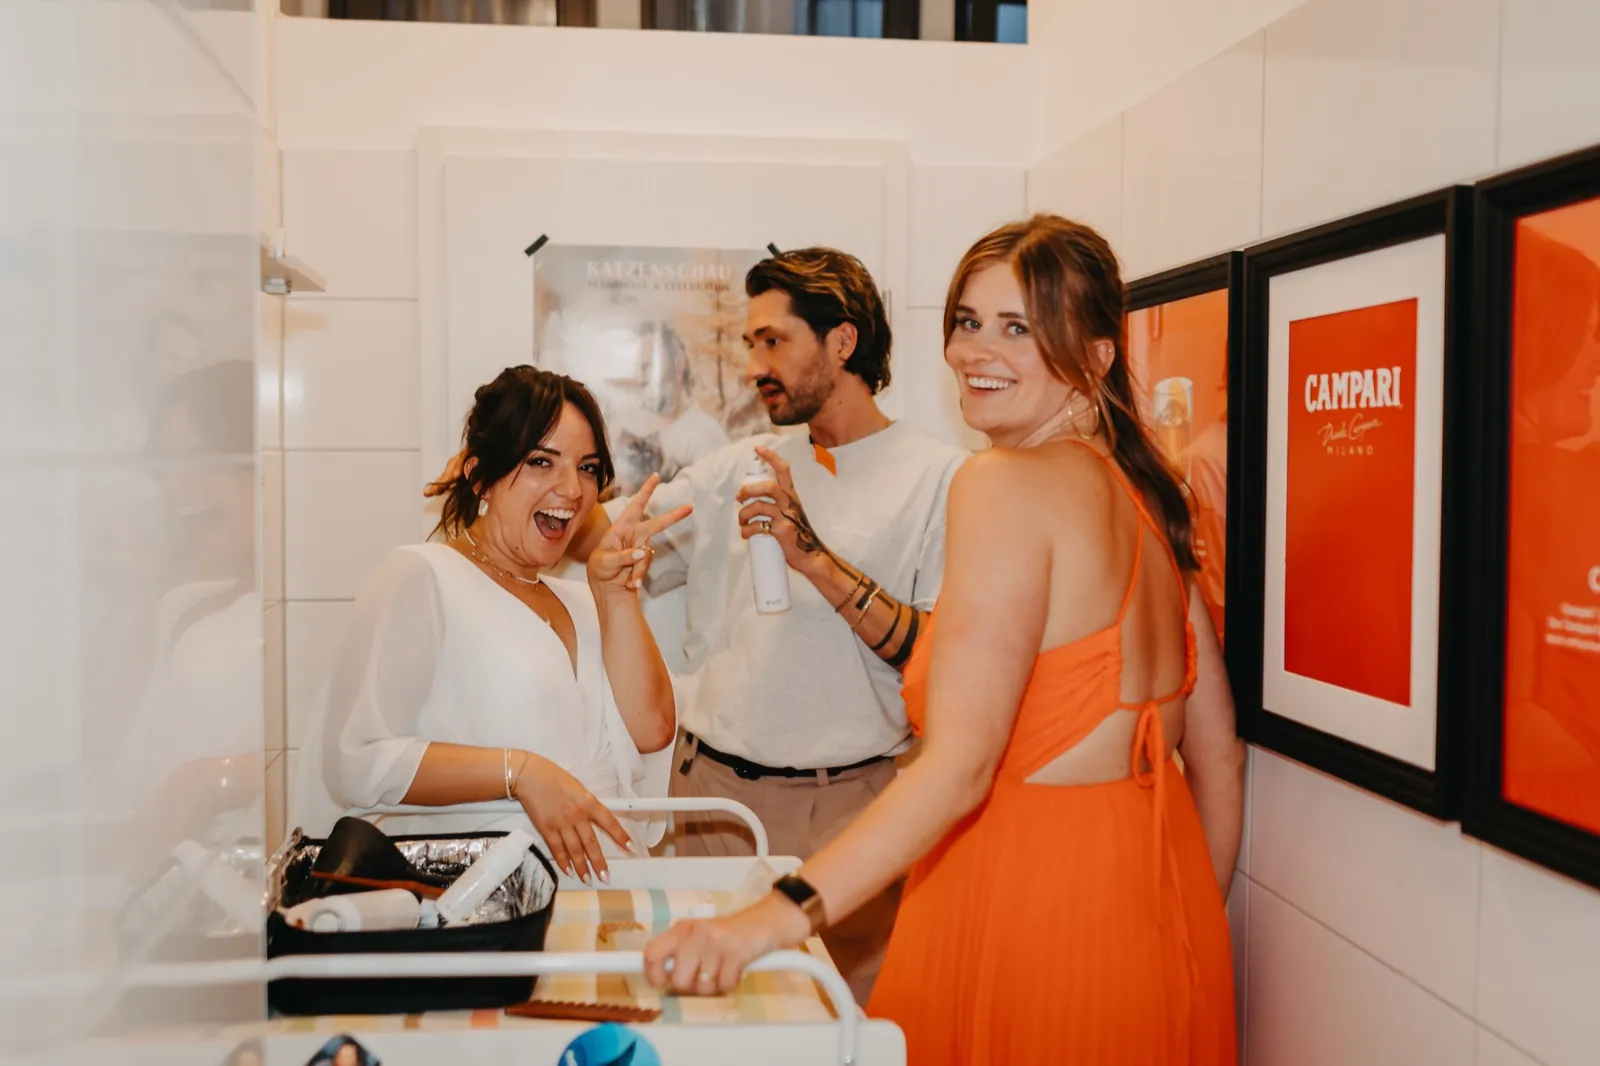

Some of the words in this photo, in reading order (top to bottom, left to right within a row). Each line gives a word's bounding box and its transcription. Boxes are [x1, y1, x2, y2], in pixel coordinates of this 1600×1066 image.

[587, 261, 732, 280] KATZENSCHAU
[1304, 366, 1402, 413] CAMPARI
[1327, 445, 1374, 456] MILANO
